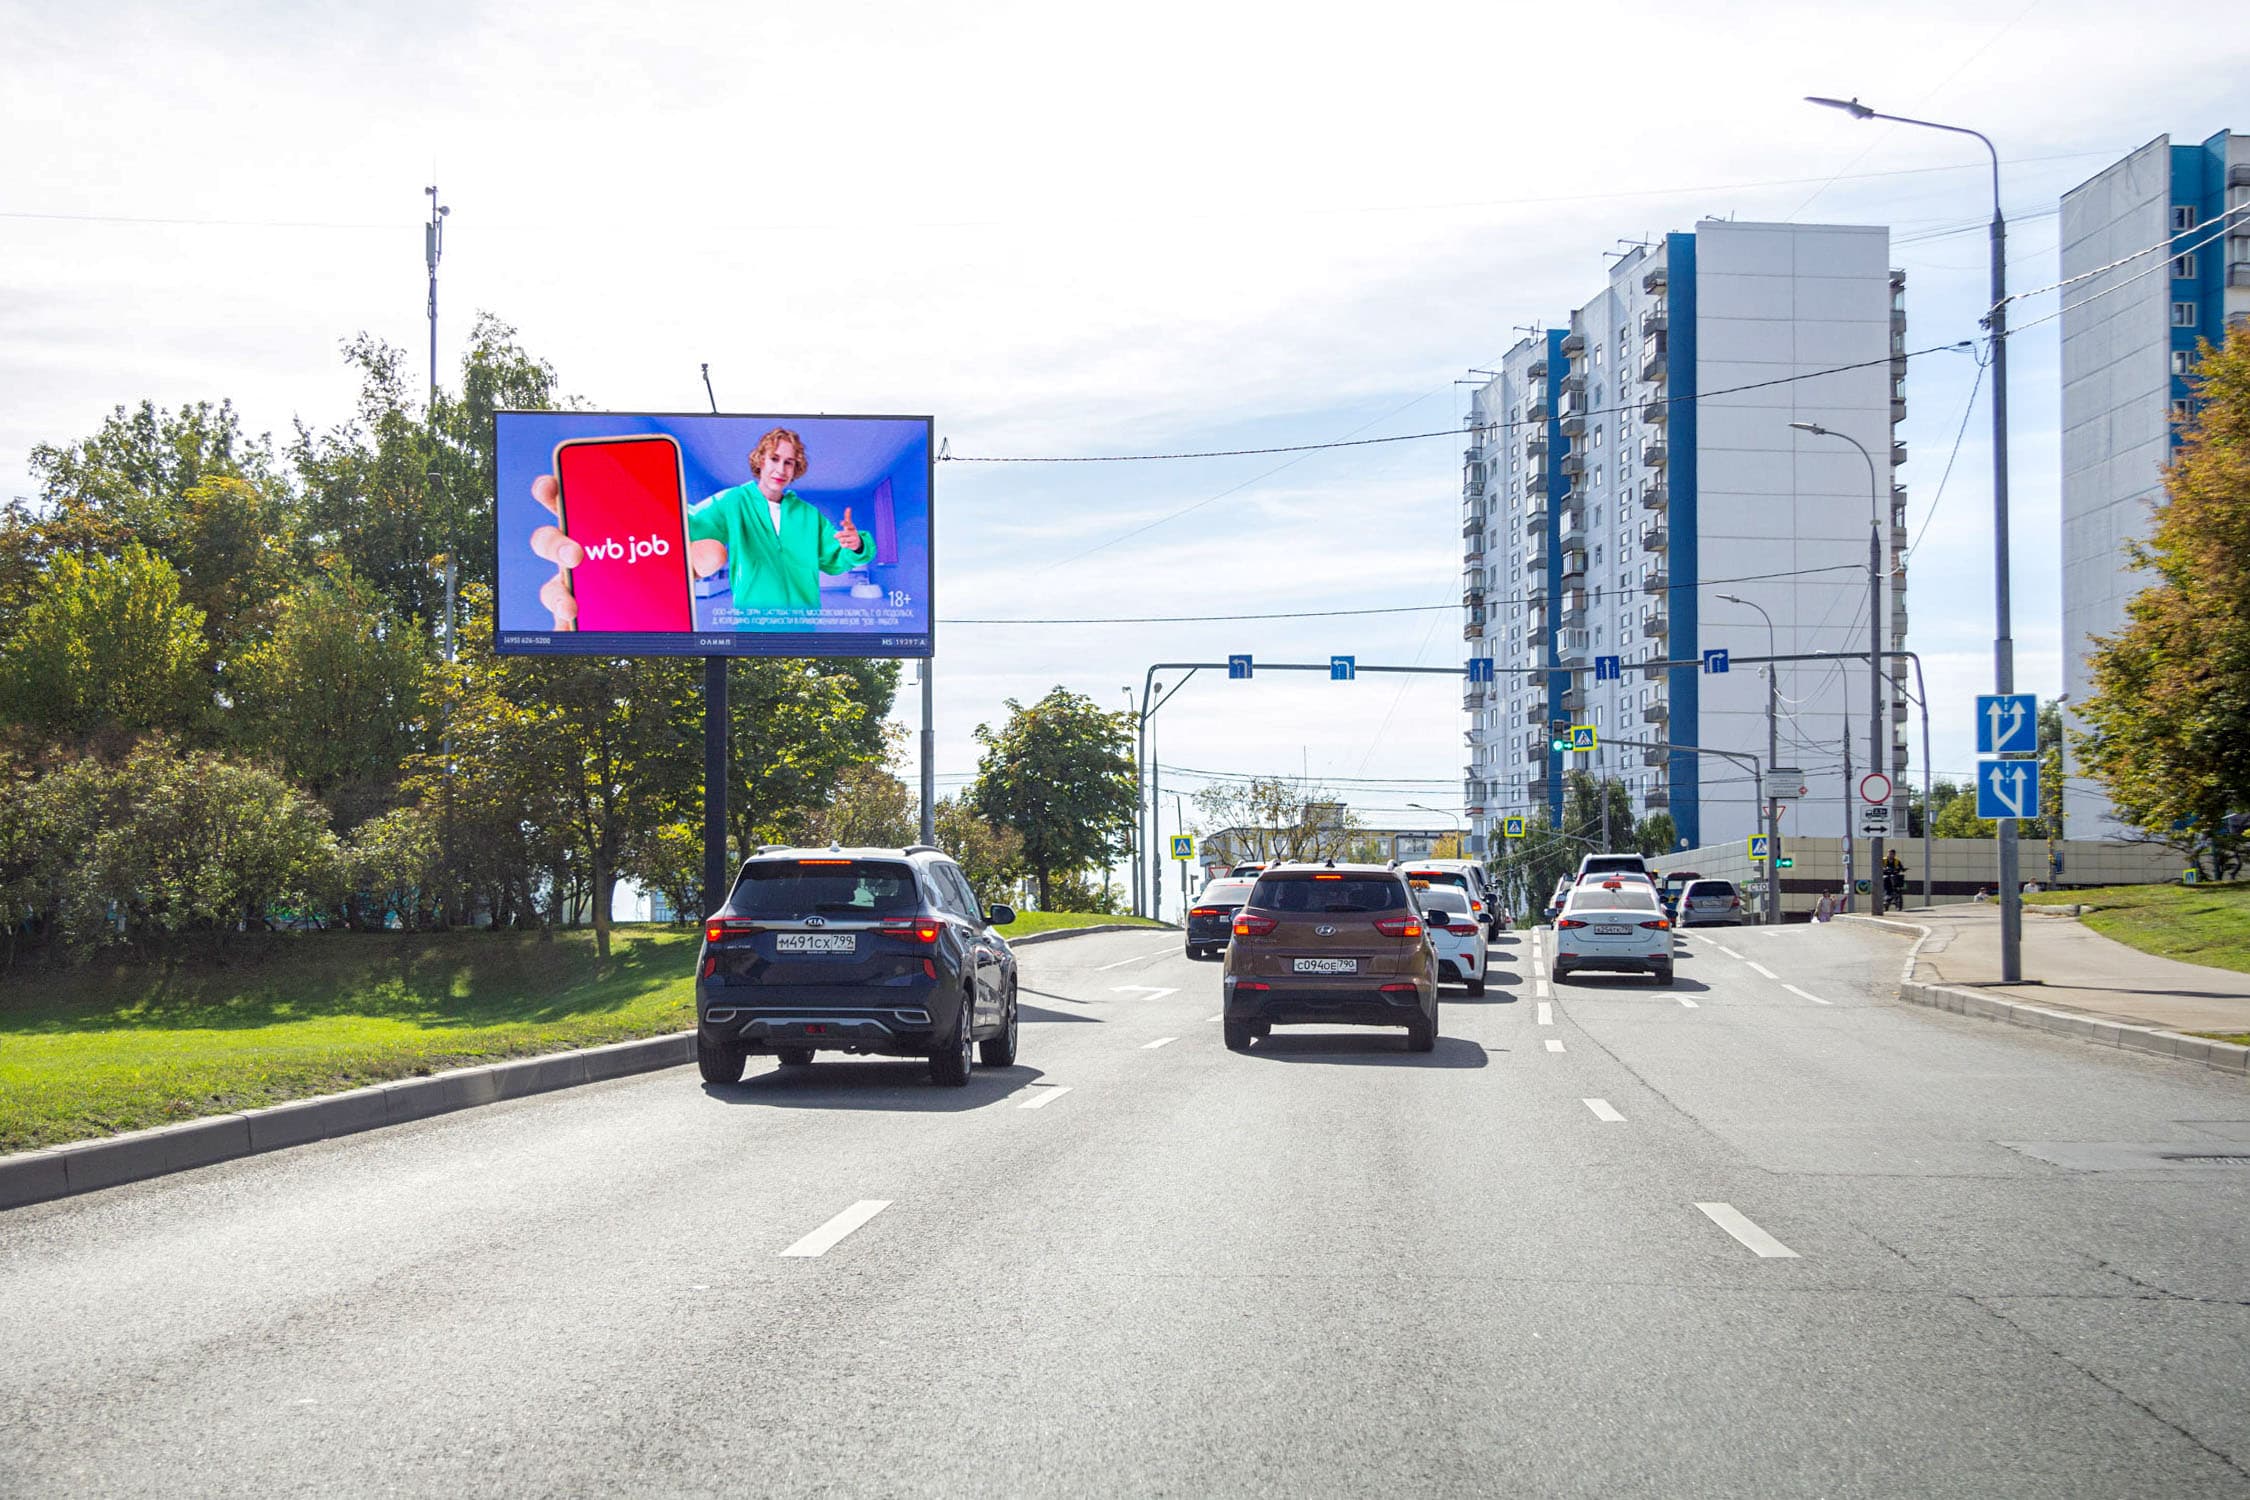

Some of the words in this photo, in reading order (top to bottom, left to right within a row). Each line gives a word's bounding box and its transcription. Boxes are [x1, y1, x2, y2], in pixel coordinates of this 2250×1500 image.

[584, 537, 624, 561] wb
[627, 533, 669, 564] job
[887, 590, 912, 607] 18+
[807, 918, 823, 927] KIA
